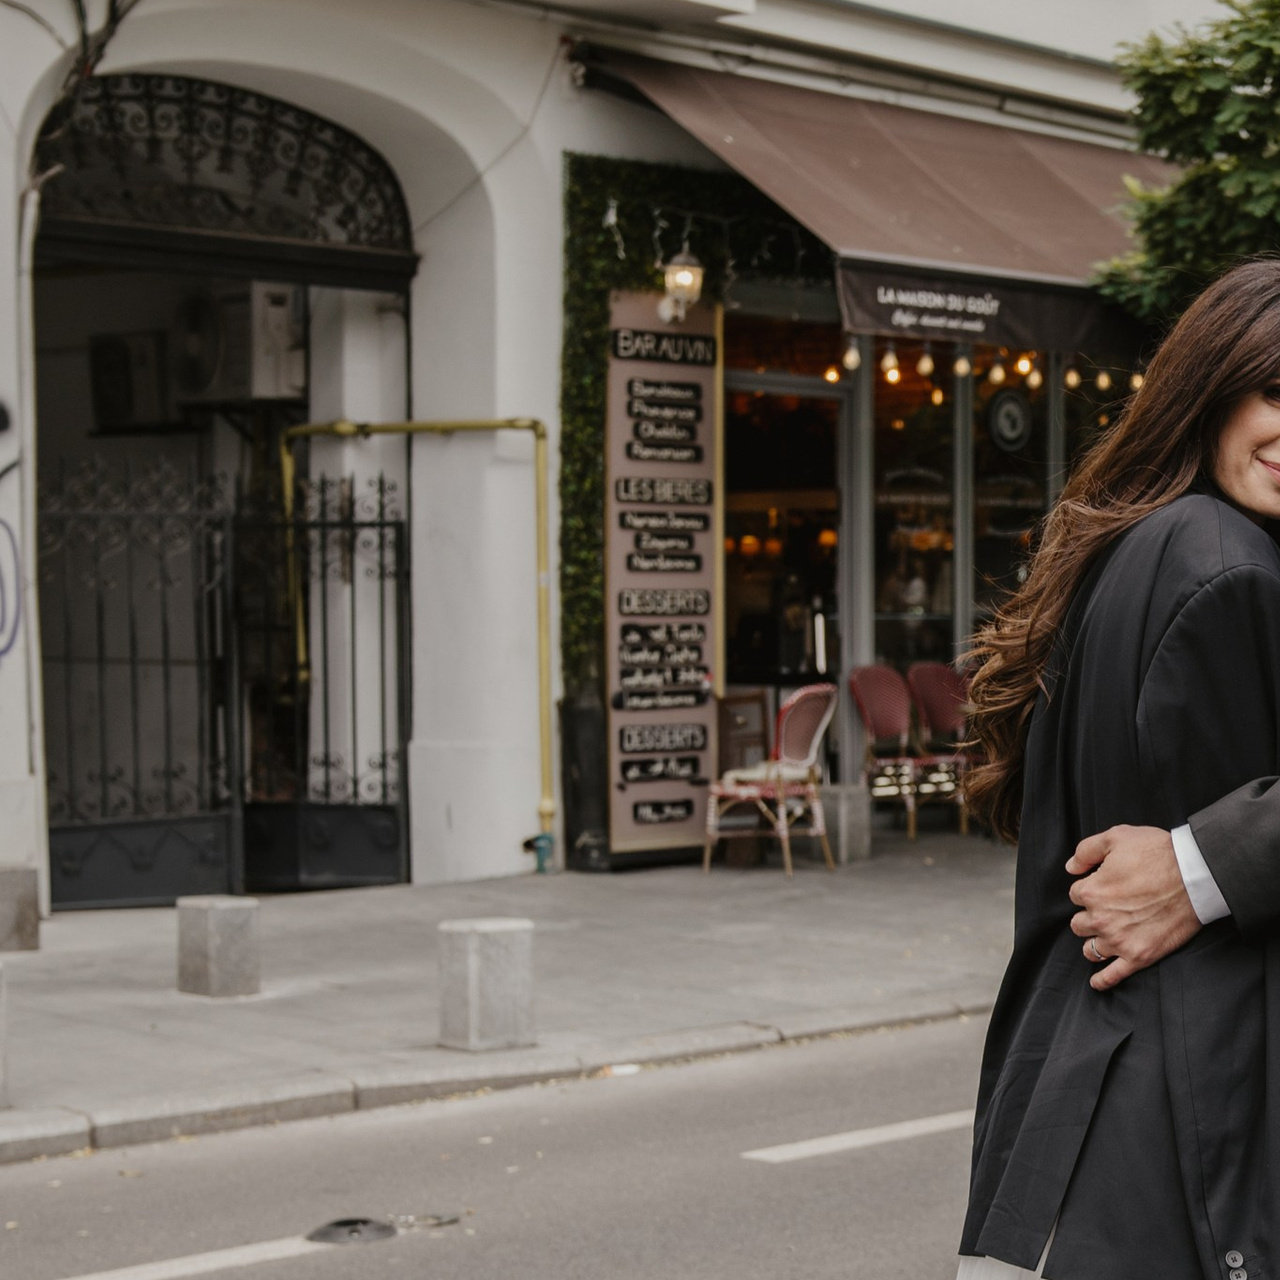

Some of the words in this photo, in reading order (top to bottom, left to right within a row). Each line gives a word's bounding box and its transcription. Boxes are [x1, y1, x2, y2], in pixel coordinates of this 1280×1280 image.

[619, 478, 652, 501] LES
[621, 588, 709, 614] DESSERTS
[622, 724, 705, 752] DESSERTS
